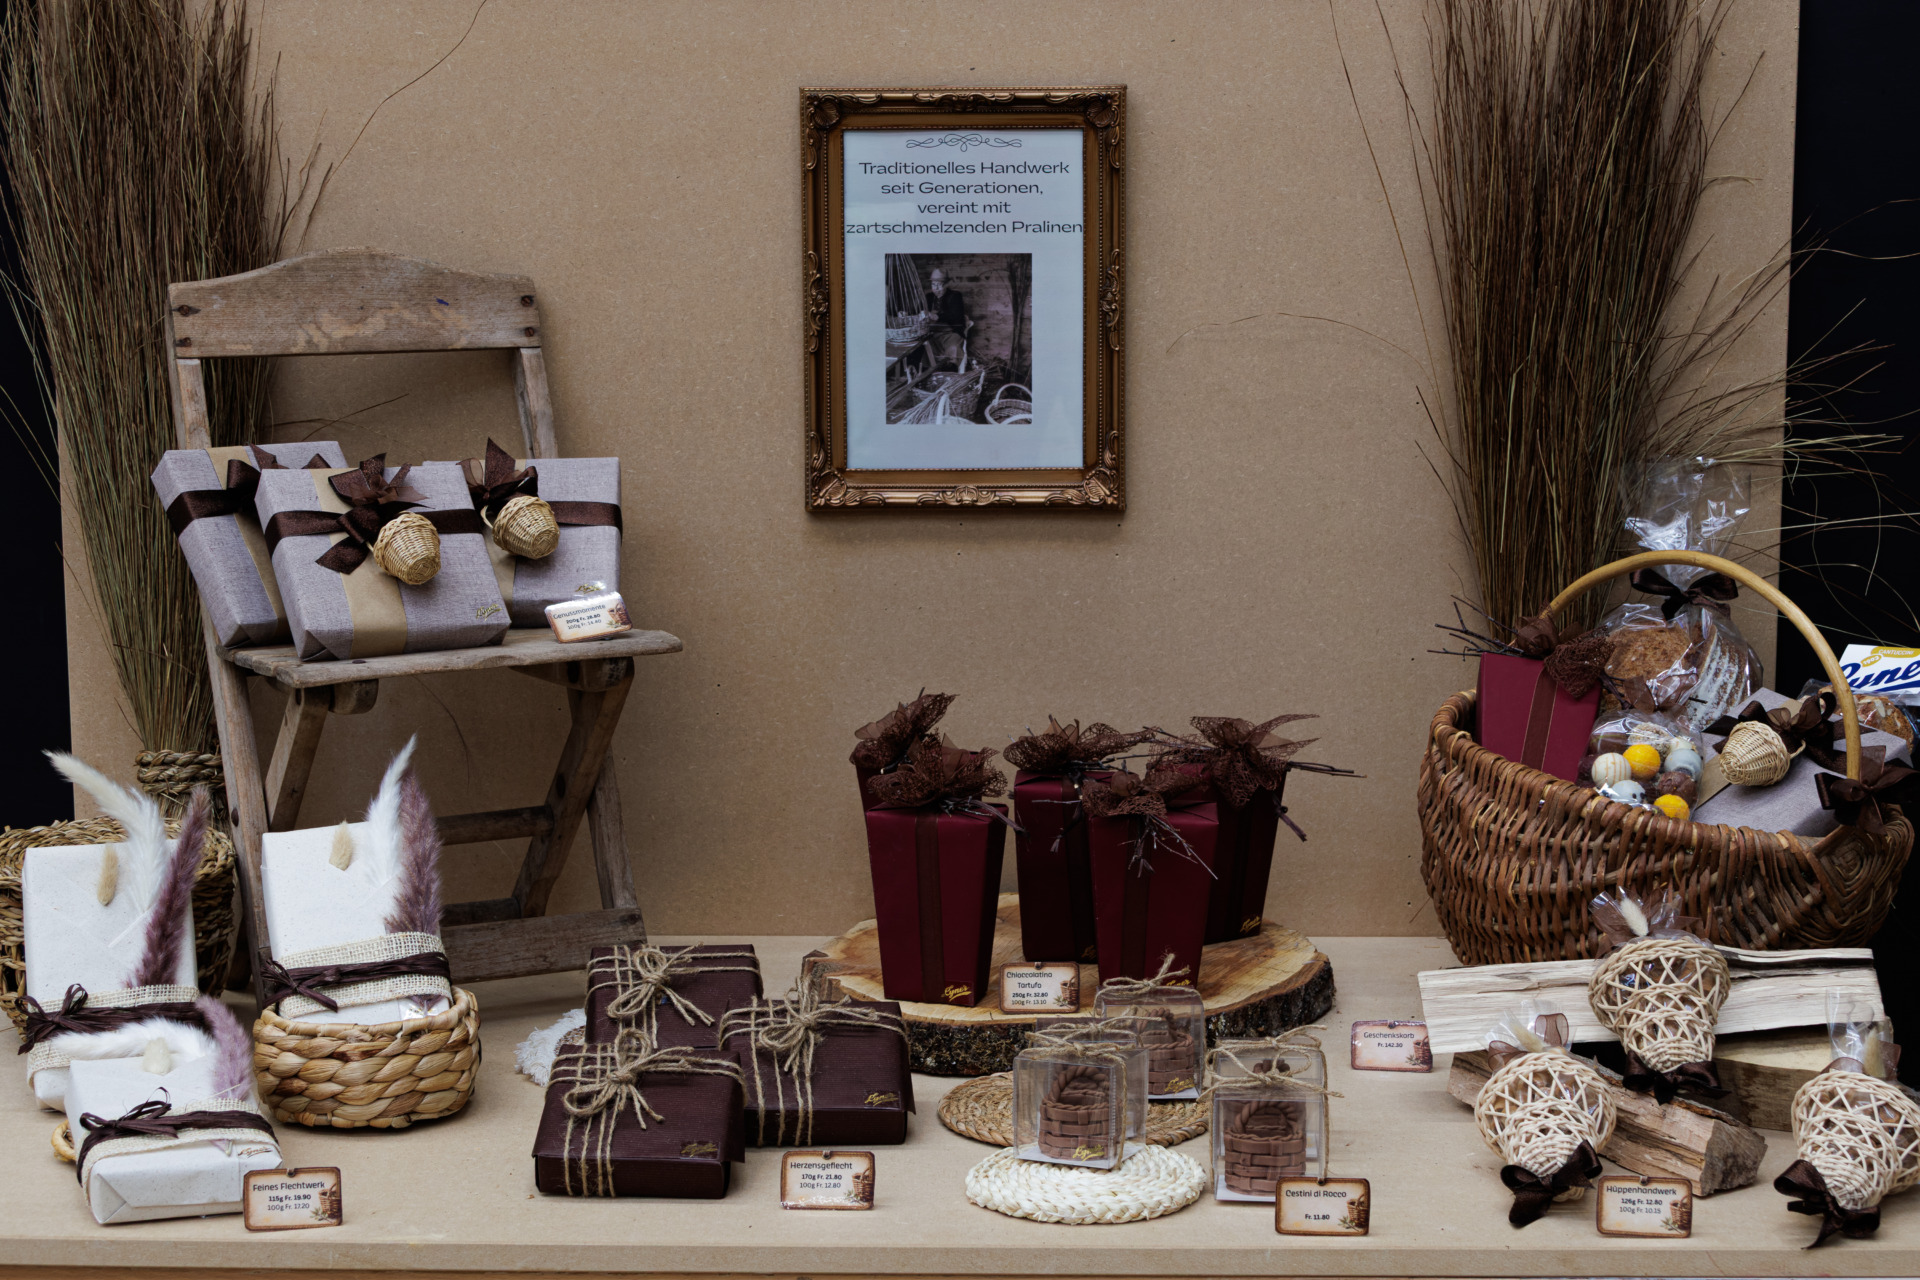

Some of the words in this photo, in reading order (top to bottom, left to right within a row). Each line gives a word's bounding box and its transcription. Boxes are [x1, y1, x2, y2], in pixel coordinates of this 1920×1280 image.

[859, 162, 976, 175] Traditionelles
[981, 161, 1070, 174] Handwerk
[881, 182, 914, 194] seit
[919, 181, 1044, 196] Generationen,
[917, 202, 978, 214] vereint
[983, 201, 1011, 214] mit
[846, 221, 1007, 234] zartschmelzenden
[1012, 220, 1083, 233] Pralinen
[553, 604, 606, 620] Genussmomente
[1862, 656, 1880, 665] 1903
[1363, 1031, 1415, 1039] Geschenkskorb
[790, 1162, 853, 1170] Herzensgeflecht
[252, 1183, 279, 1192] Feines
[280, 1181, 325, 1190] Flechtwerk
[1606, 1185, 1677, 1196] Hüppenhandwerk
[1285, 1189, 1312, 1197] Cestini
[1323, 1190, 1347, 1198] Rocco
[268, 1195, 284, 1203] 115g
[1621, 1198, 1636, 1206] 126g
[267, 1204, 285, 1212] 100g
[1619, 1206, 1635, 1214] 100g
